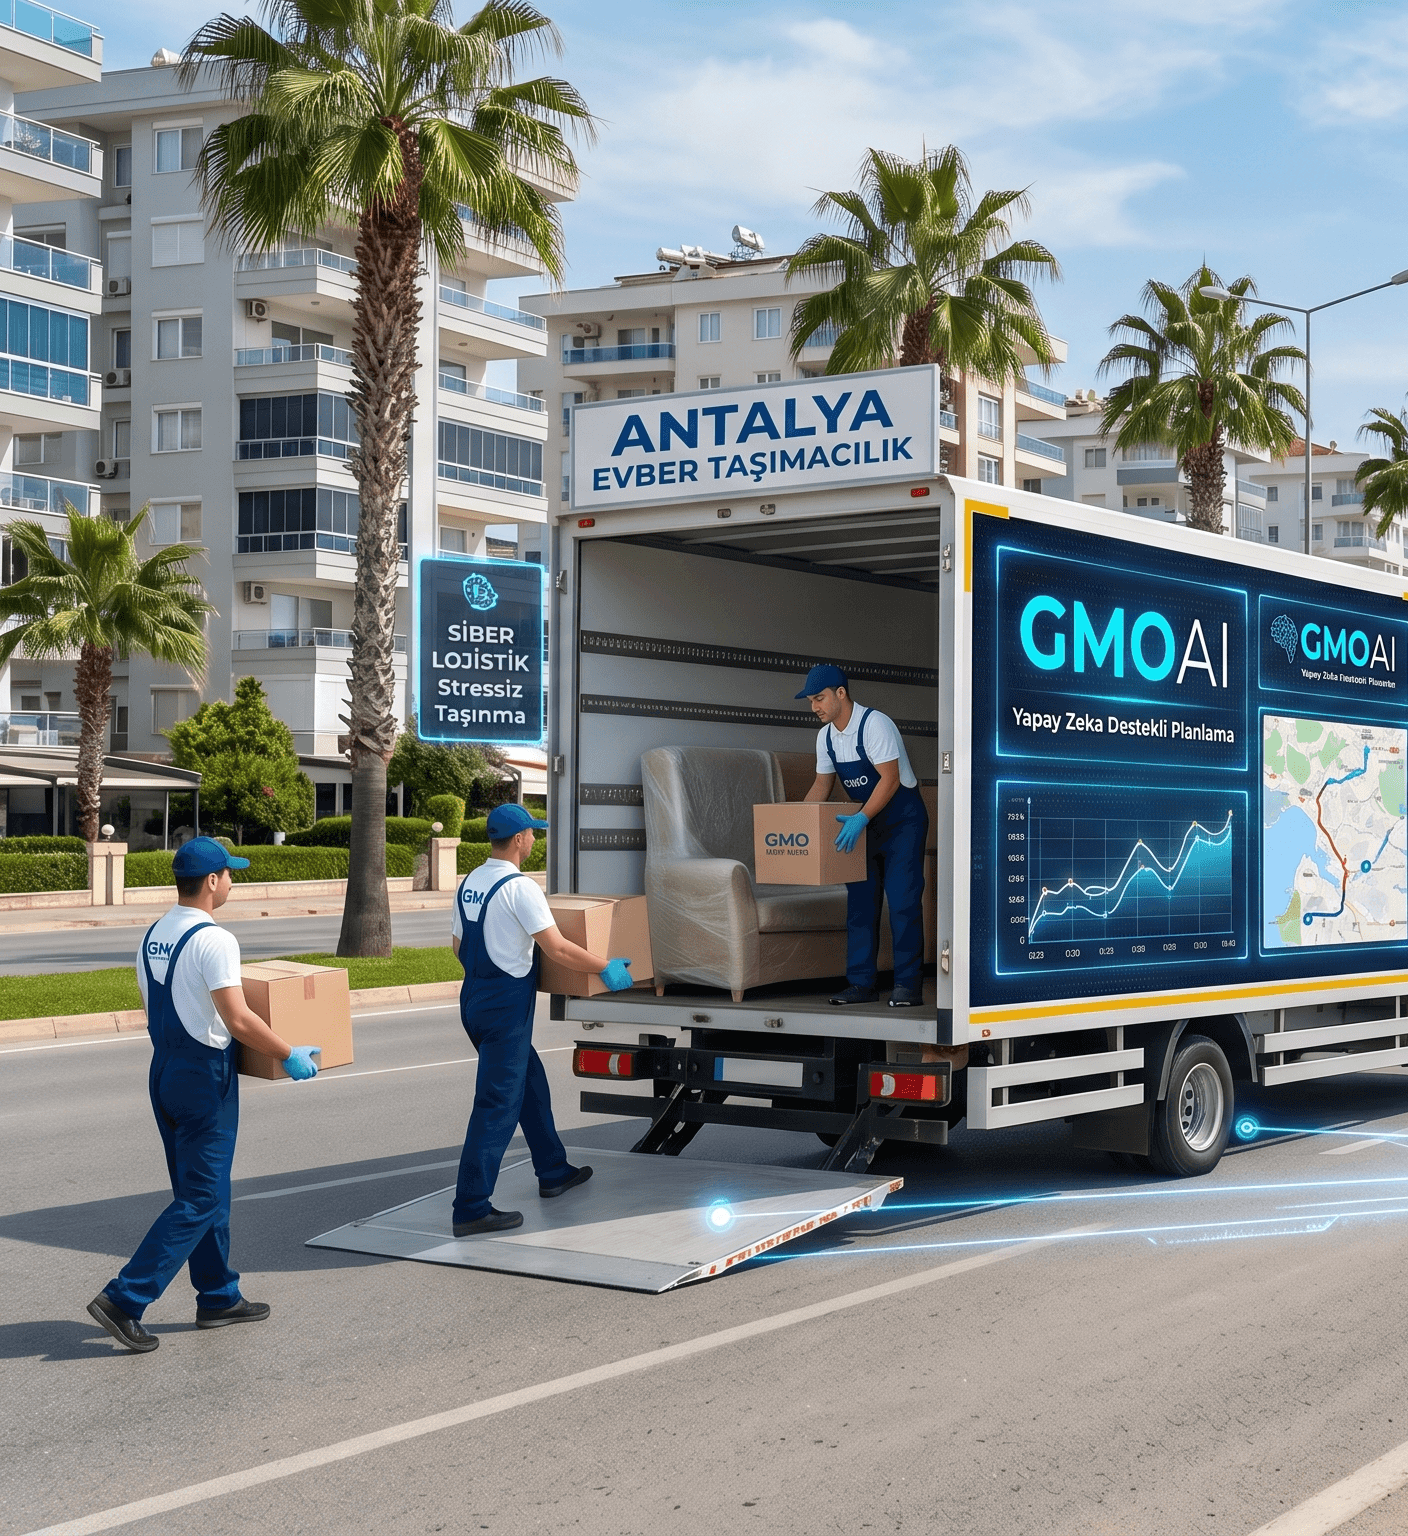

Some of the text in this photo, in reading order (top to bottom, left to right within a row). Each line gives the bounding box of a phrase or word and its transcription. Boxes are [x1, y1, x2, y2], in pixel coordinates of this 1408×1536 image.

[611, 390, 893, 457] ANTALYA
[593, 436, 913, 492] EVBER TAŞIMACILIK
[1012, 707, 1235, 743] Yapay Zeka Destekli Planlama
[765, 833, 810, 847] GMO
